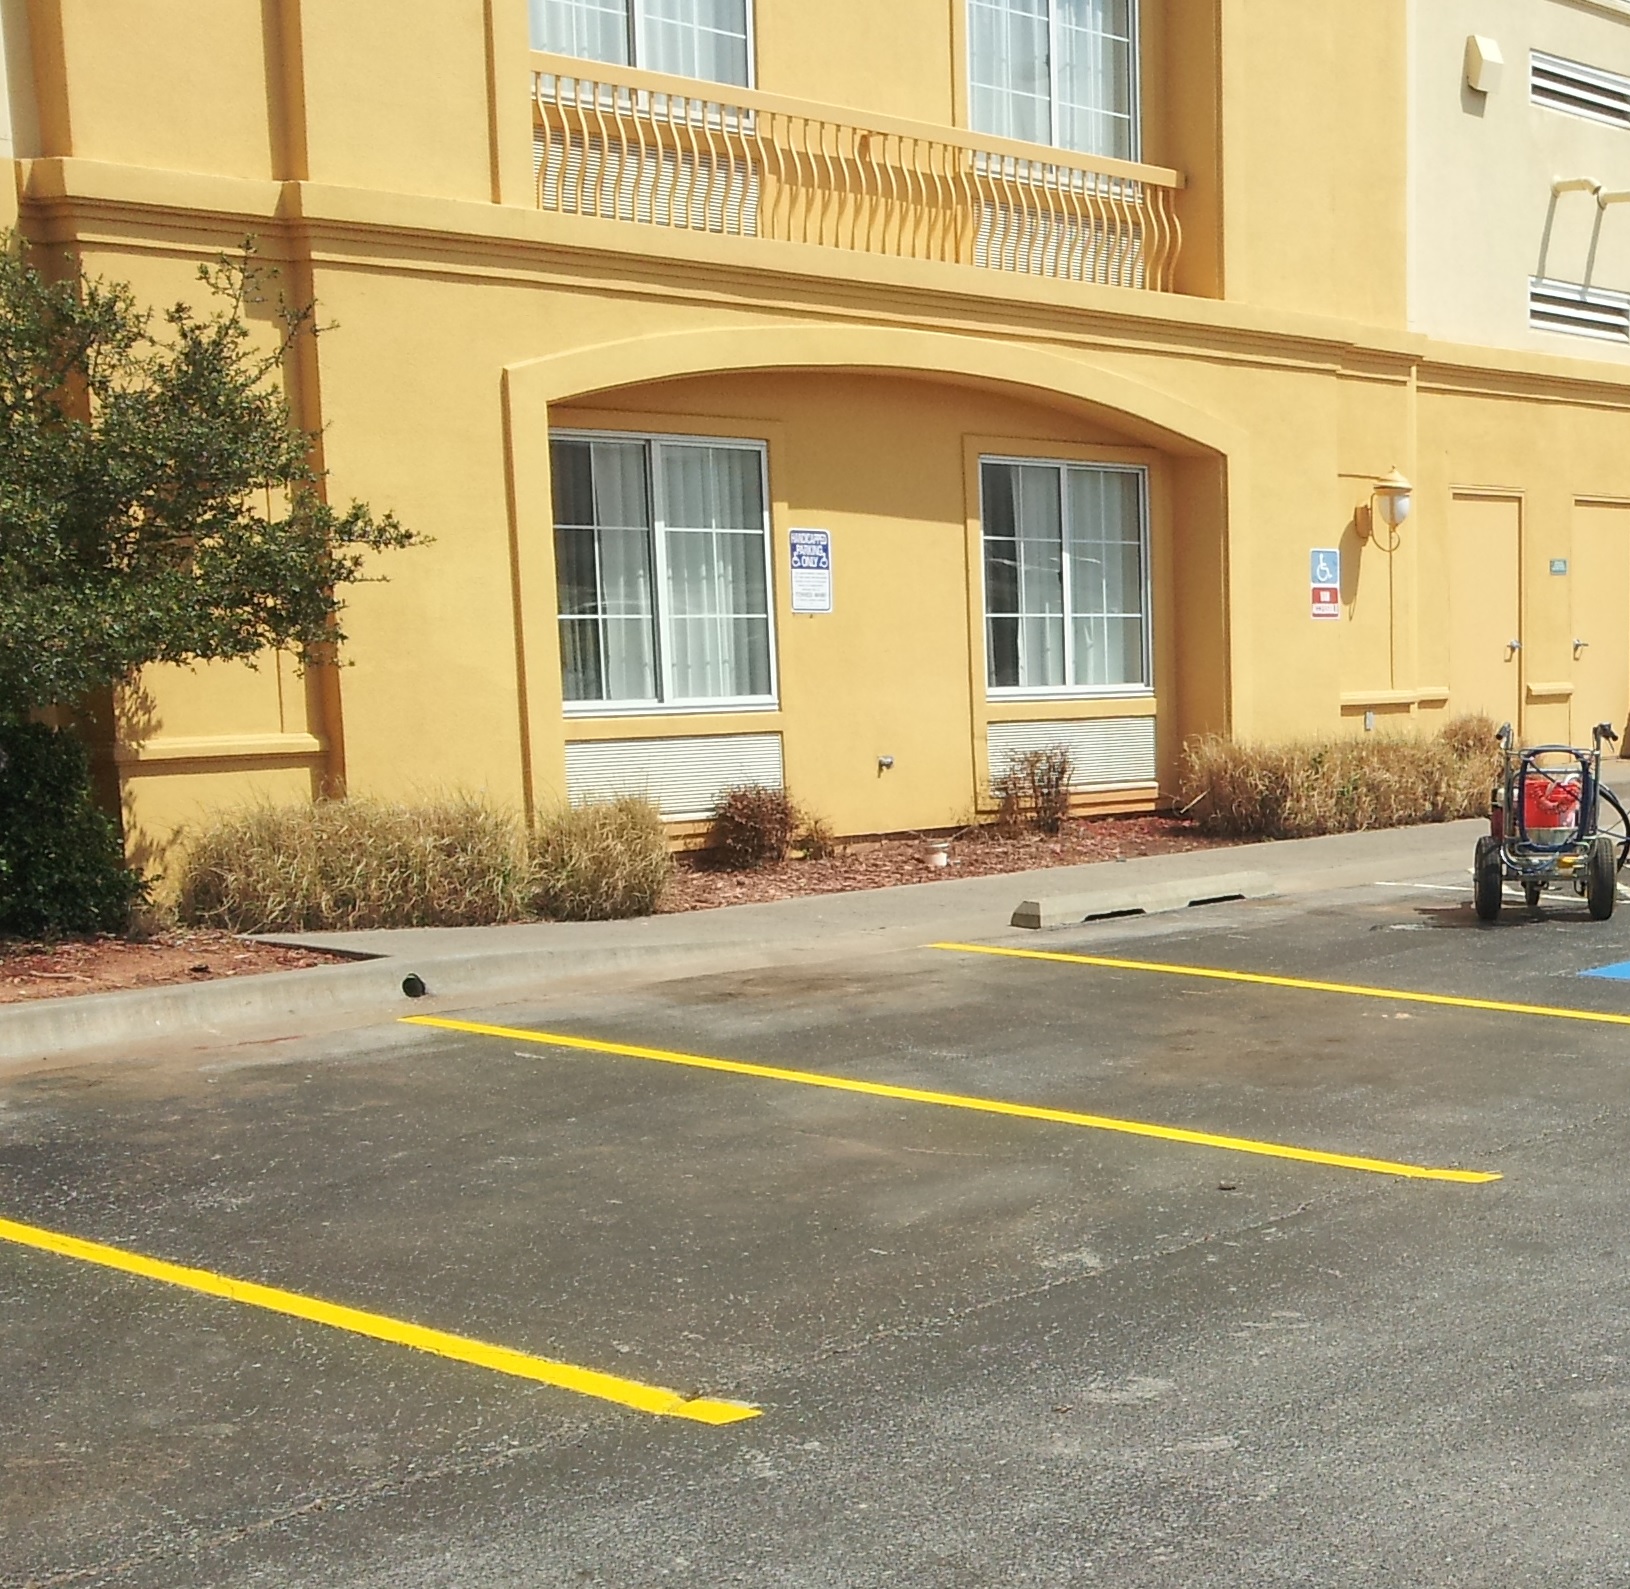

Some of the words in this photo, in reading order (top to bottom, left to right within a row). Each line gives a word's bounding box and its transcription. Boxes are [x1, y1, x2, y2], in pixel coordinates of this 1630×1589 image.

[790, 532, 827, 545] HANDICAPPED
[795, 544, 823, 556] PARKING
[801, 556, 819, 567] ONLY
